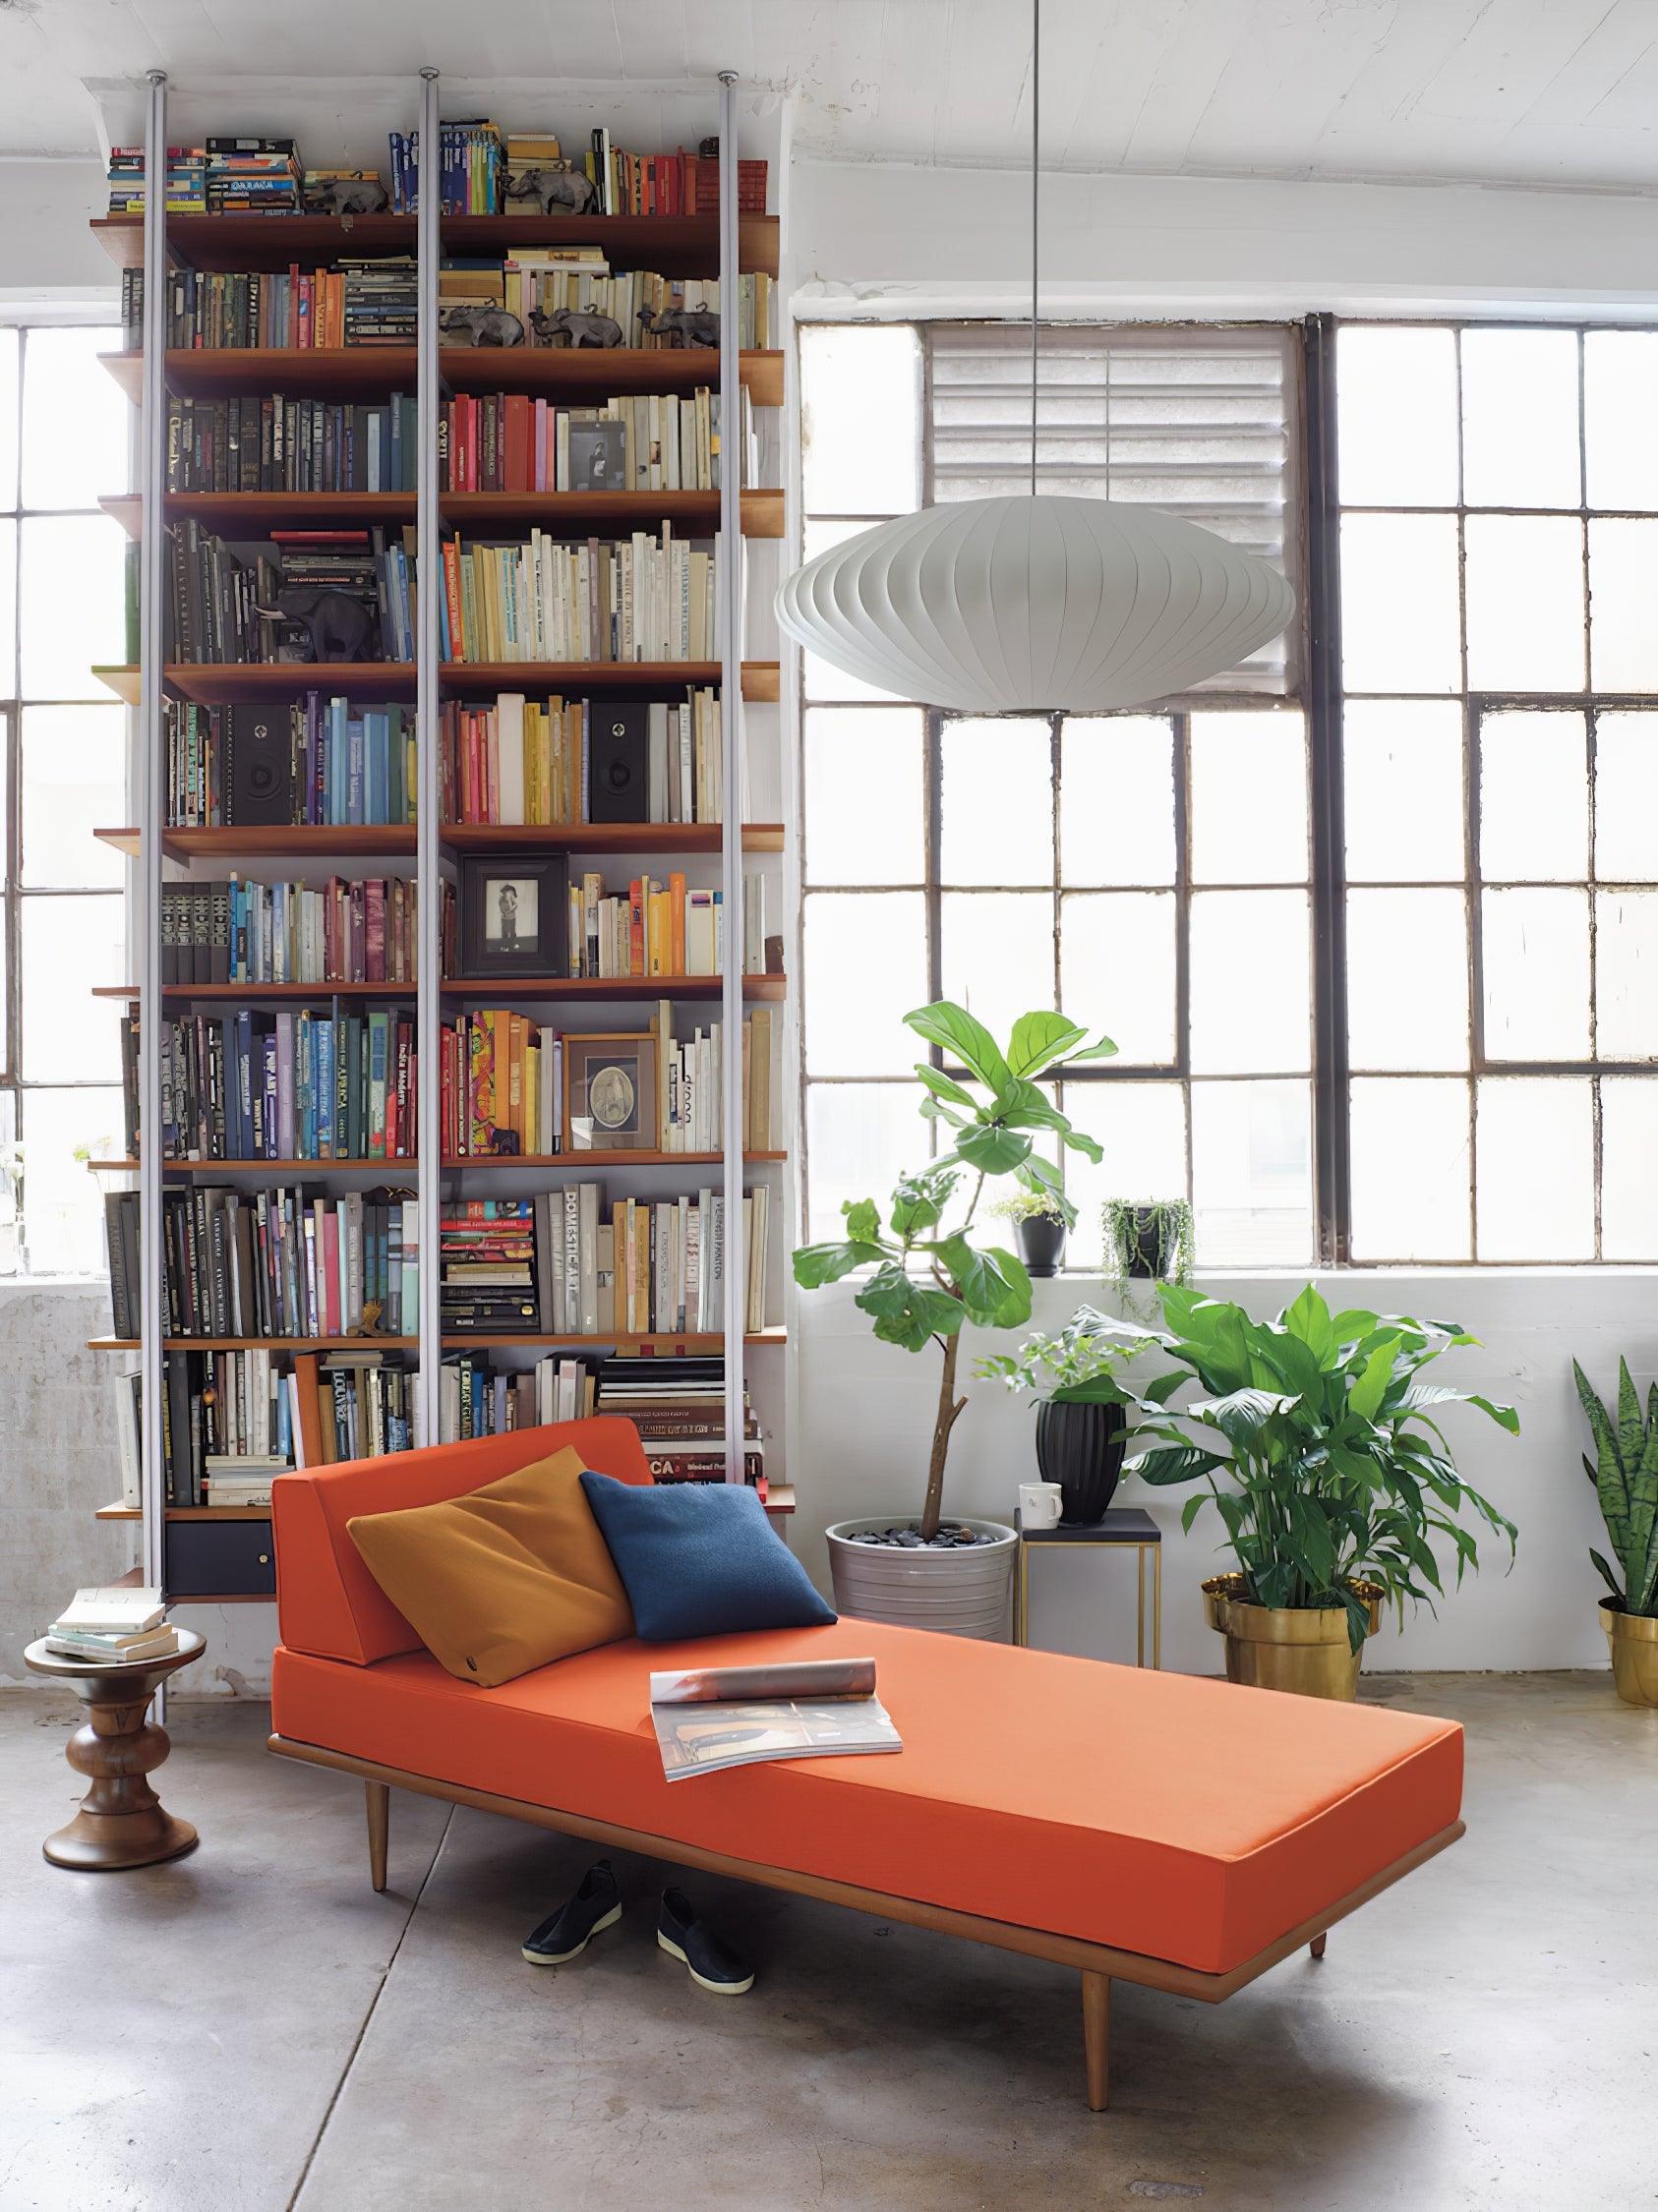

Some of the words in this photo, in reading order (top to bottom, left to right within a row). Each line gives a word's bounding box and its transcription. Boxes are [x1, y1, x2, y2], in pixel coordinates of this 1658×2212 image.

[398, 1043, 408, 1068] India
[337, 1067, 348, 1110] AFRICA
[397, 1070, 407, 1106] Modern
[332, 1370, 347, 1423] LOUVRE
